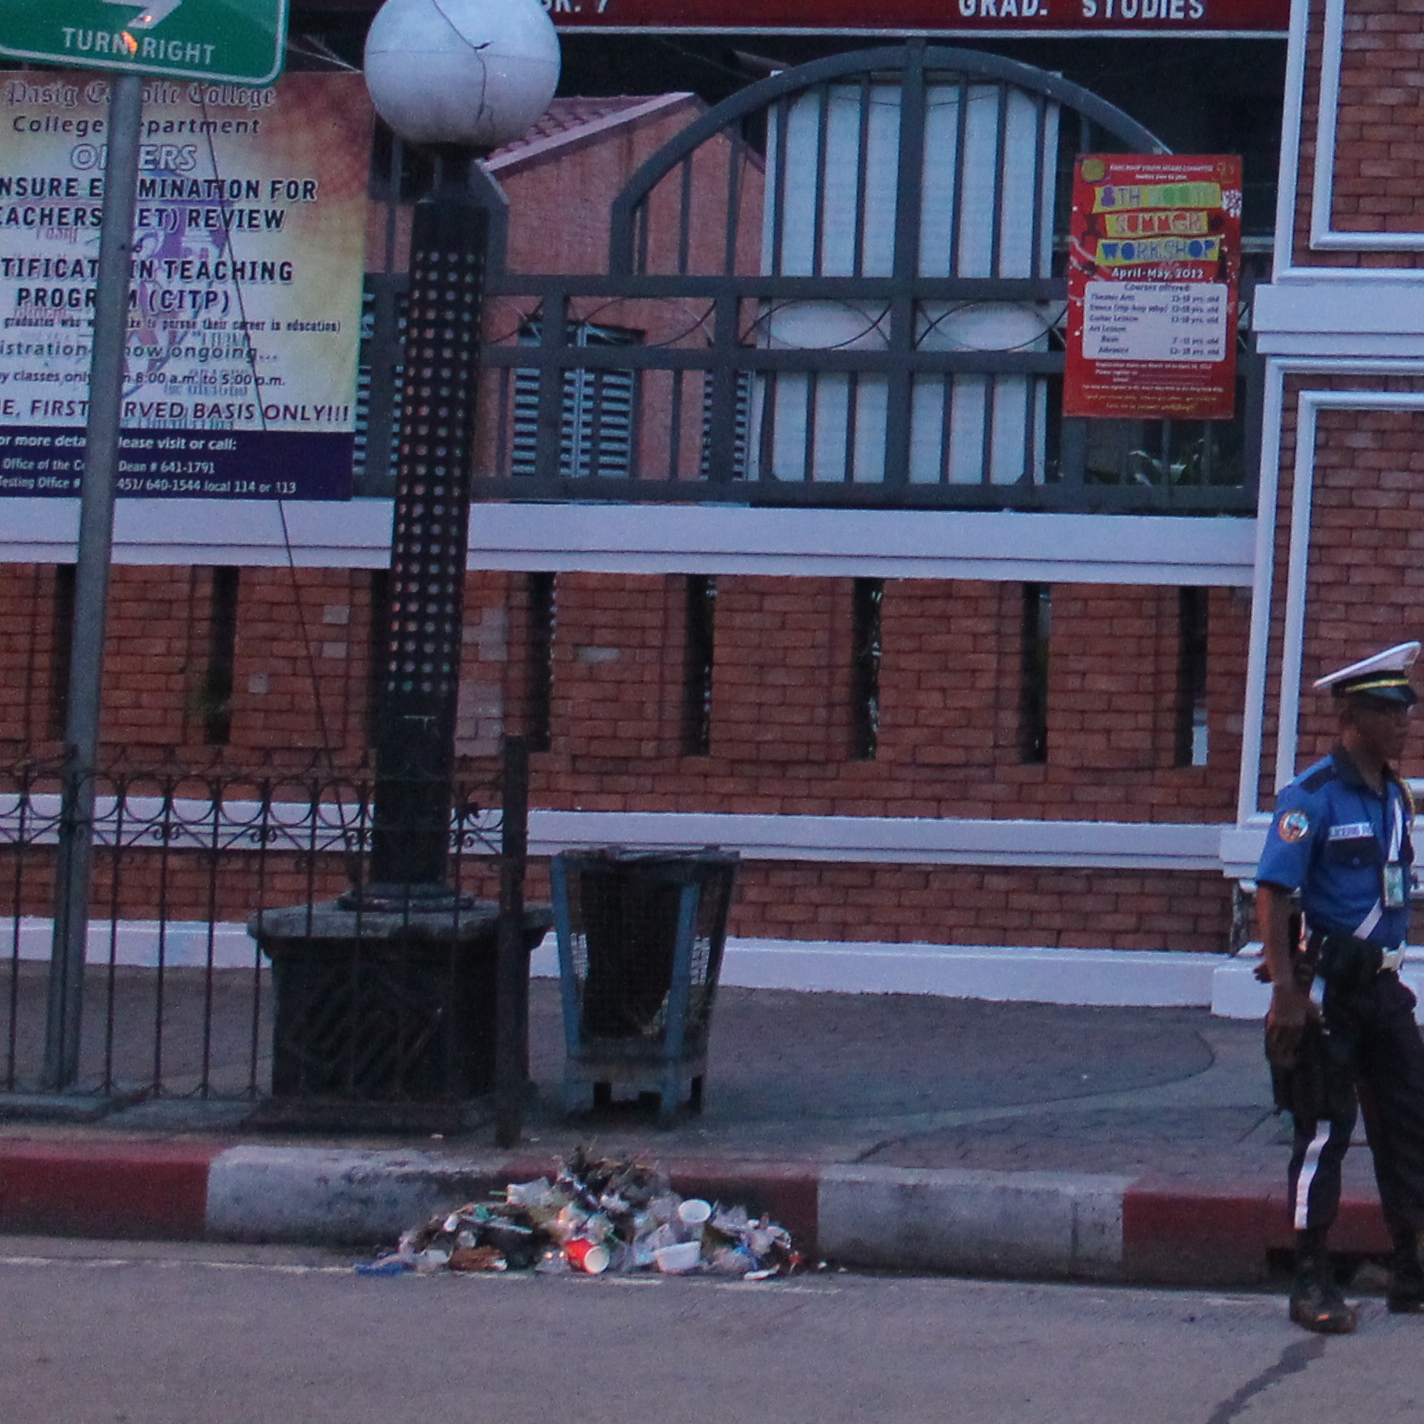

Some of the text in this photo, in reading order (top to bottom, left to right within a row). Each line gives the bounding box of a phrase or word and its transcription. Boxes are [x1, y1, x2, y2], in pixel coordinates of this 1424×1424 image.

[61, 27, 216, 66] TURN RIGHT
[8, 79, 277, 110] Pasig Colic College
[13, 116, 261, 137] College partment
[71, 143, 198, 171] OERS
[89, 178, 260, 199] EMINATION
[270, 179, 317, 200] FOR
[1101, 185, 1141, 207] 8TH
[138, 208, 179, 231] ET)
[188, 208, 285, 228] REVIEW
[1101, 239, 1215, 261] WORKSHOP
[1, 258, 293, 282] TIFICAT IN TEACHING
[1176, 269, 1204, 280] 2012
[18, 287, 229, 314] PROGRM (CITP)
[125, 345, 162, 357] now
[14, 370, 61, 382] classes
[170, 374, 200, 385] a.m.
[203, 373, 218, 385] to
[221, 374, 251, 386] 5:00
[255, 376, 286, 389] p.m.
[31, 399, 91, 417] FIRST
[124, 401, 185, 420] RVED
[193, 402, 255, 420] BASIS
[264, 404, 349, 422] ONLY!!!
[15, 436, 51, 447] more
[118, 436, 153, 449] lease
[157, 437, 186, 449] visit
[190, 439, 205, 450] or
[208, 437, 237, 451] call:
[3, 458, 34, 470] Office
[37, 458, 50, 470] of
[52, 458, 70, 470] the
[118, 460, 147, 472] Dean
[37, 477, 70, 488] Office
[204, 479, 230, 493] local
[259, 483, 271, 494] or
